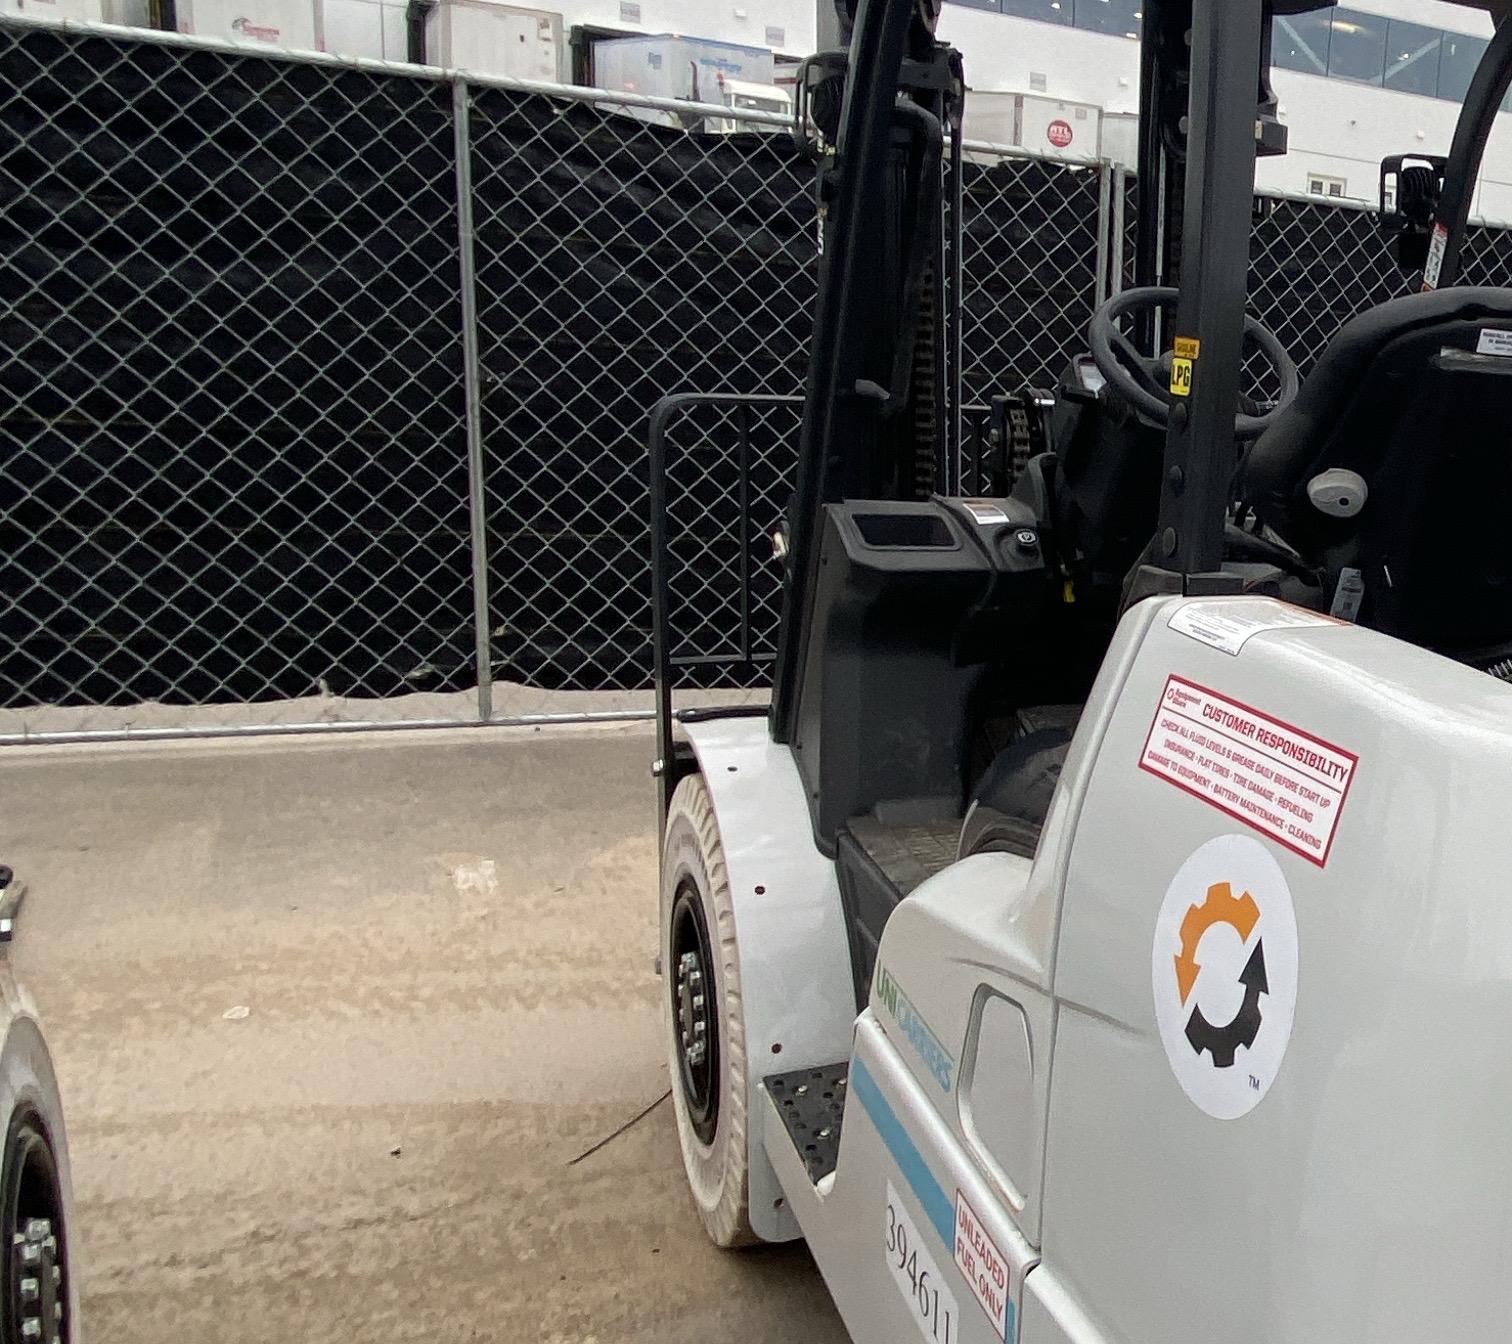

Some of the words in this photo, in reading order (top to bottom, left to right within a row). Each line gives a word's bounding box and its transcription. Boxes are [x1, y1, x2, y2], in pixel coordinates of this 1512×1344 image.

[1171, 364, 1190, 387] LPG
[1161, 719, 1180, 733] CHECK
[1180, 725, 1189, 739] ALL
[1189, 731, 1206, 746] FLUID
[1206, 739, 1226, 756] LEVELS
[1232, 752, 1256, 771] GREASE
[1255, 763, 1274, 780] DAILY
[1274, 773, 1299, 793] BEFORE
[1299, 786, 1320, 805] START
[1320, 796, 1331, 808] UP
[1164, 738, 1195, 761] INSURANCE
[1197, 755, 1212, 769] FLAT
[1212, 763, 1230, 779] TIRES
[1233, 772, 1248, 789] TIRE
[1247, 781, 1275, 802] DAMAGE
[1277, 796, 1313, 823] REFUELING
[1203, 703, 1256, 739] CUSTOMER
[1255, 728, 1348, 782] RESPONSIBILITY
[1170, 761, 1178, 772] TO
[1177, 765, 1212, 790] EQUIPMENT
[1213, 784, 1240, 804] BATTERY
[1240, 798, 1285, 830] MAINTENANCE
[1288, 824, 1322, 850] CLEANING
[1248, 1074, 1260, 1091] TM
[957, 1236, 978, 1285] FUEL
[979, 1273, 1003, 1323] ONLY
[958, 1204, 1005, 1290] UNLEADED
